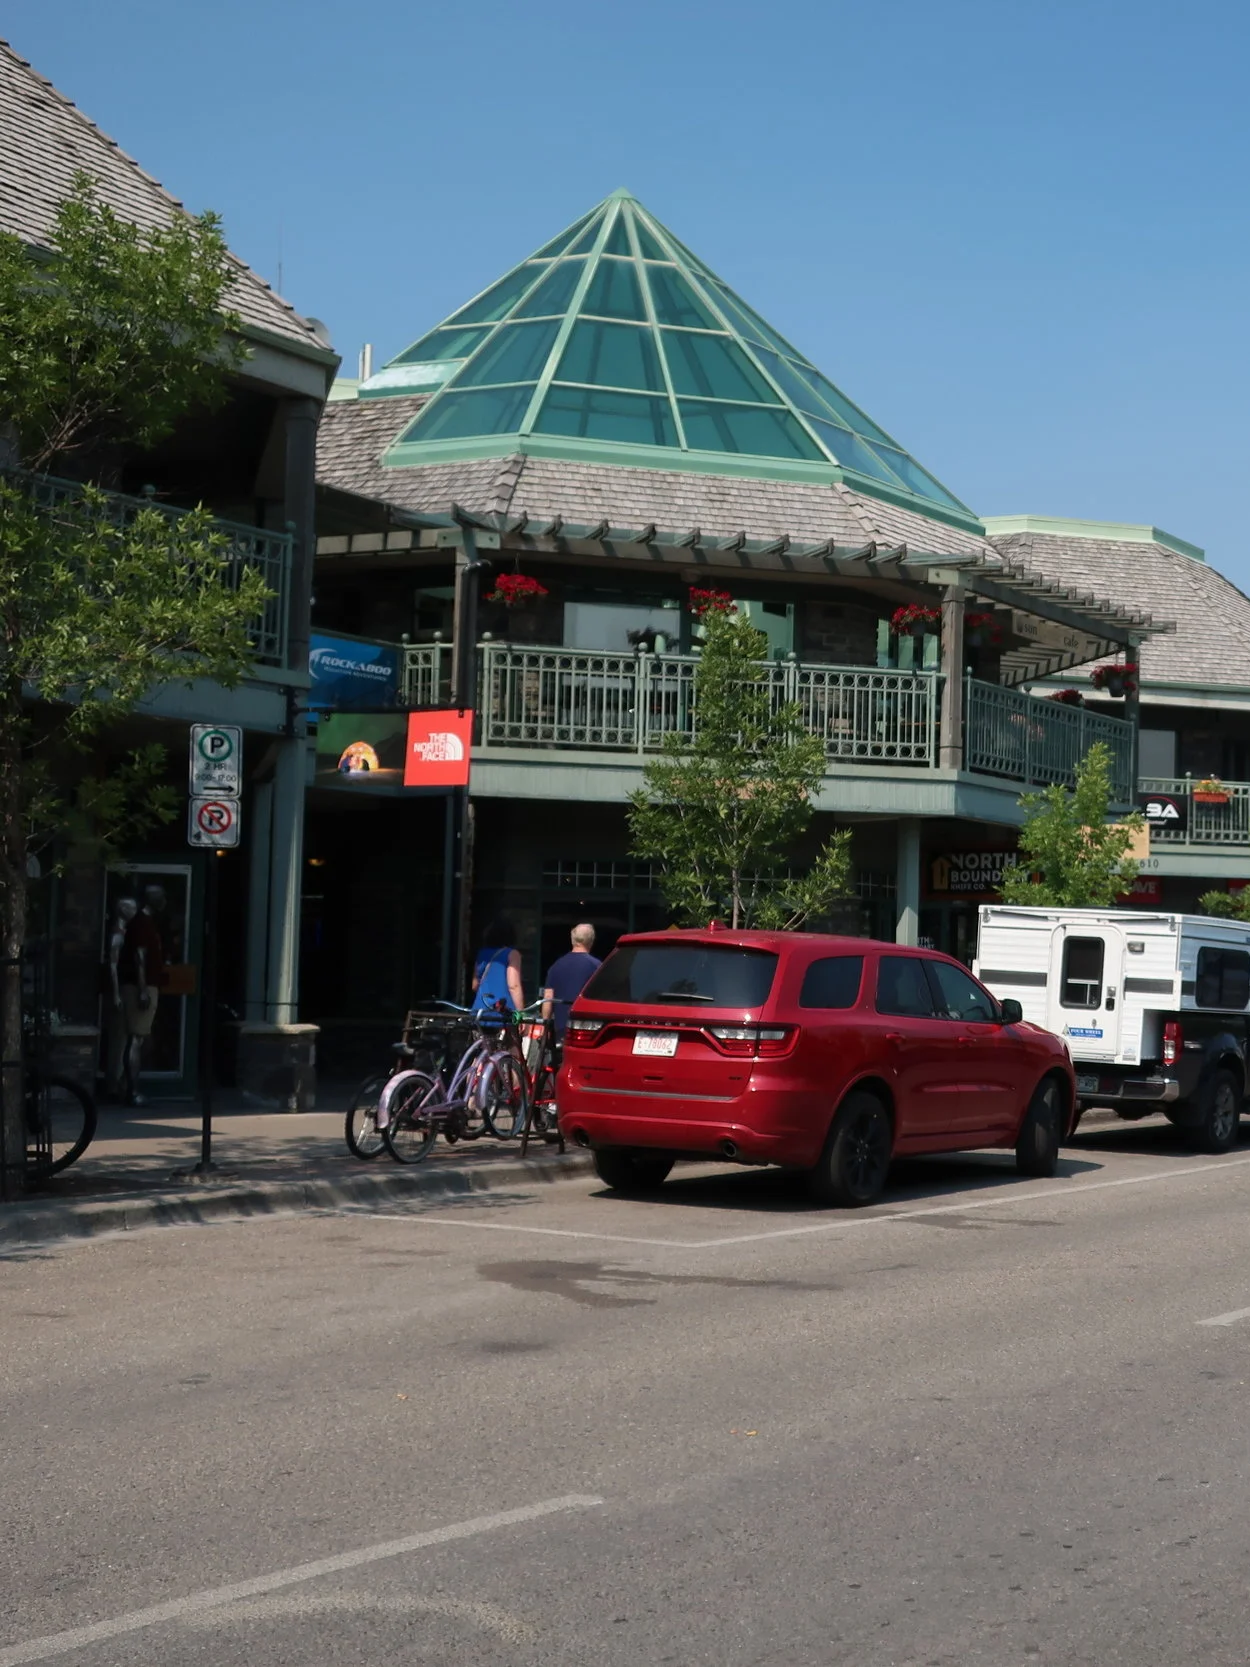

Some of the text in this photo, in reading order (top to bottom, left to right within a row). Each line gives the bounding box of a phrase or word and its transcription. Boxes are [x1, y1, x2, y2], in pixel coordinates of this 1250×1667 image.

[320, 655, 392, 676] ROCKABOO
[428, 733, 448, 742] THE
[210, 736, 225, 753] P
[413, 743, 448, 753] NORTH
[421, 753, 448, 761] FACE
[950, 853, 1016, 869] NORTH
